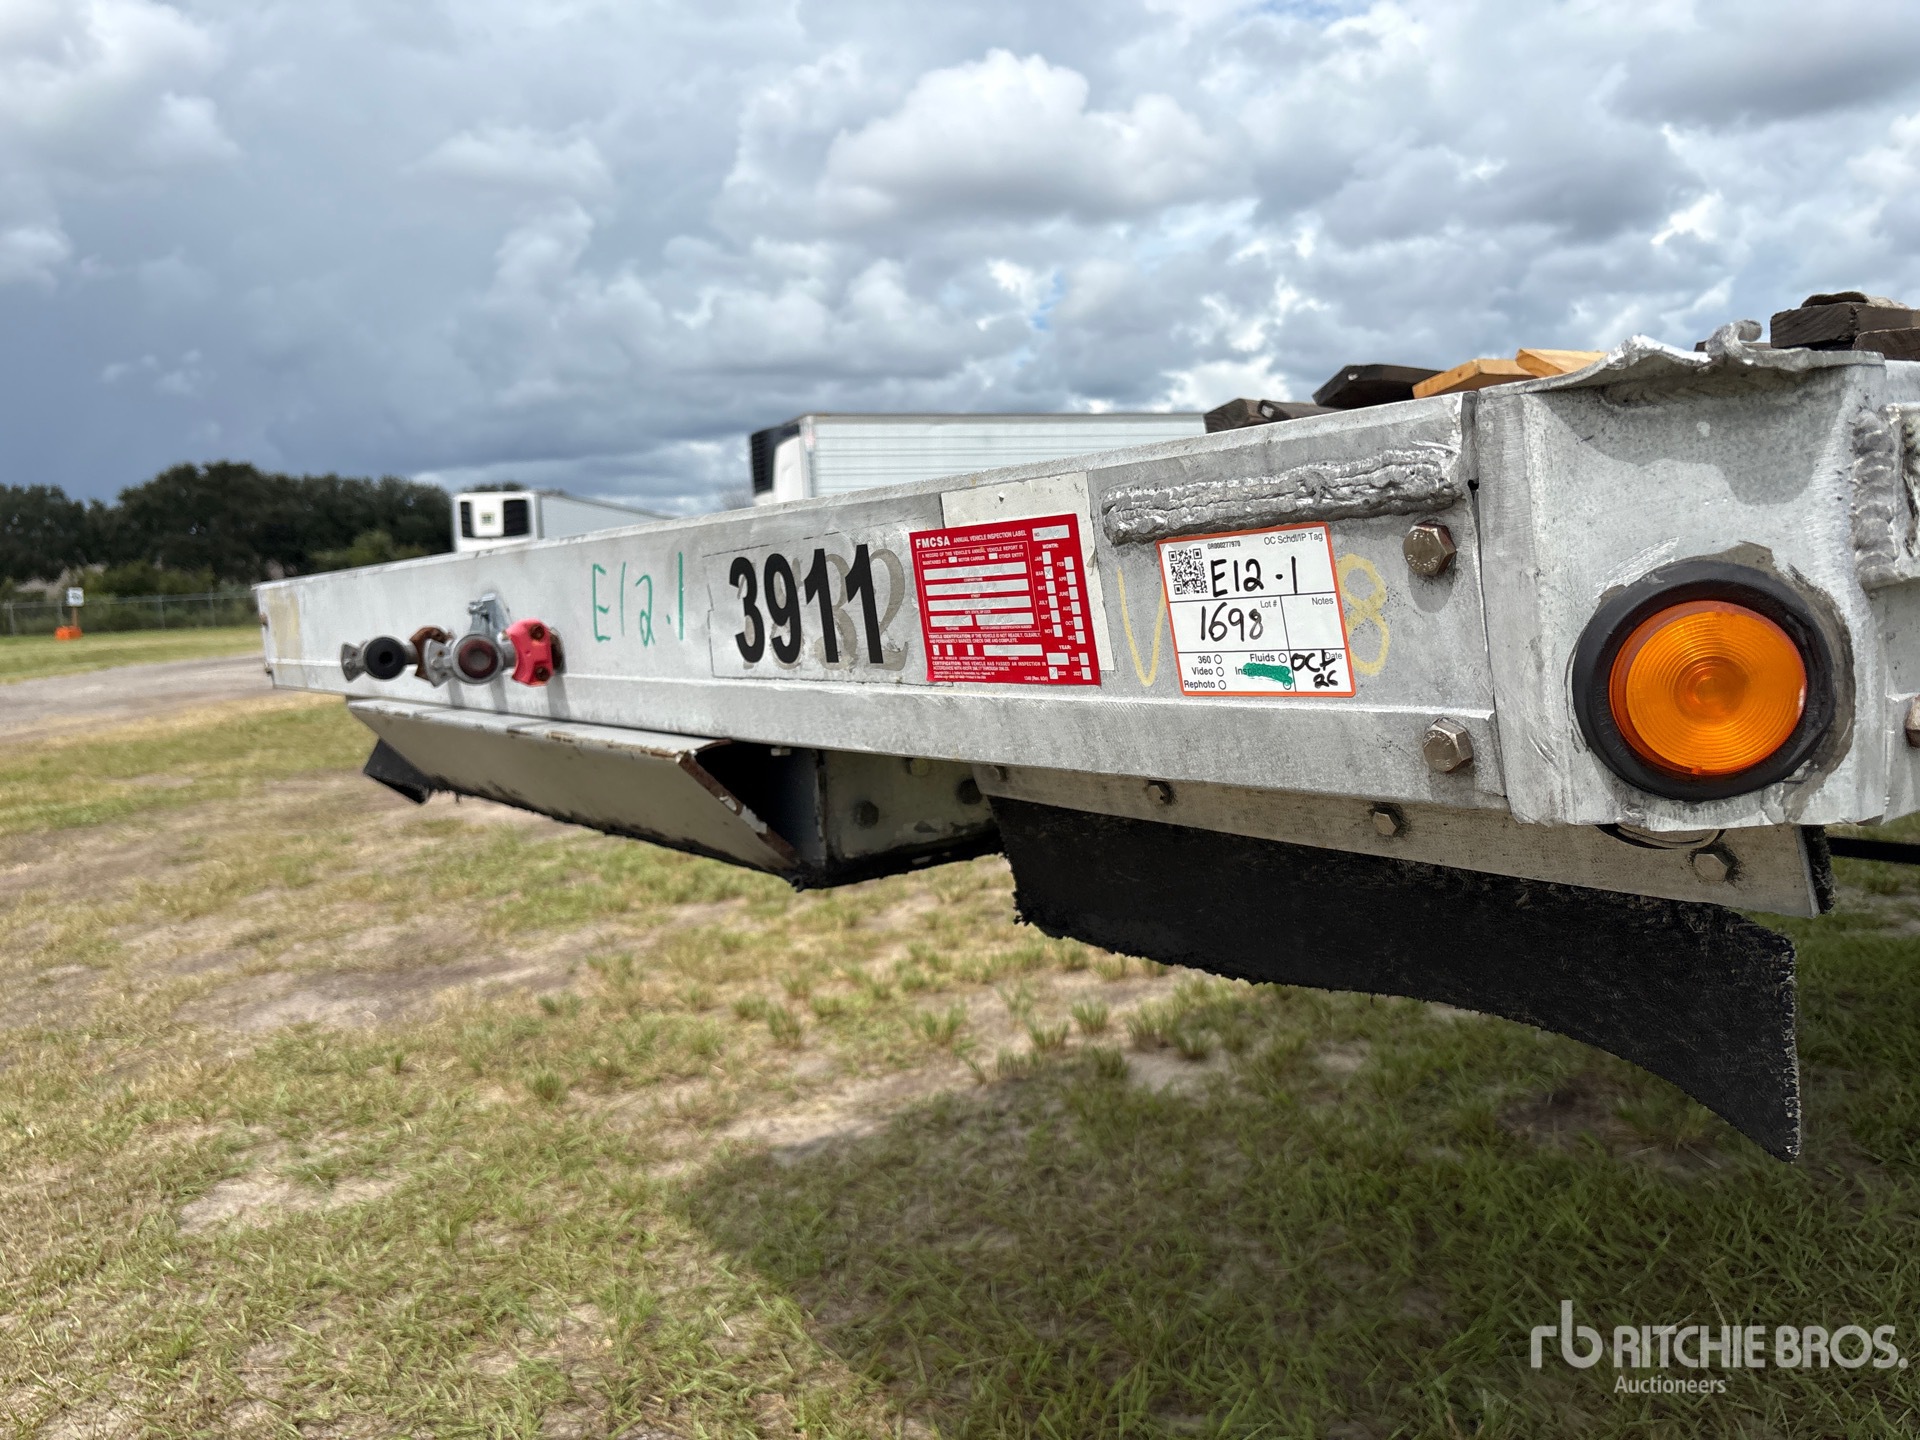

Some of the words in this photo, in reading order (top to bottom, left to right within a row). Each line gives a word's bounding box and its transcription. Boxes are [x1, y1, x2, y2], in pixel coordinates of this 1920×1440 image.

[916, 536, 950, 548] FMCSA
[987, 531, 1012, 540] INSPECTION
[1264, 536, 1276, 545] OC
[1308, 533, 1323, 542] Tag
[729, 544, 884, 664] 3911
[1260, 600, 1271, 609] Lot
[1312, 597, 1334, 606] Notes
[1201, 602, 1264, 642] 1698
[1198, 656, 1211, 664] 360
[1250, 653, 1275, 662] Fluids
[1192, 667, 1213, 676] Video
[1184, 680, 1216, 691] Rephoto
